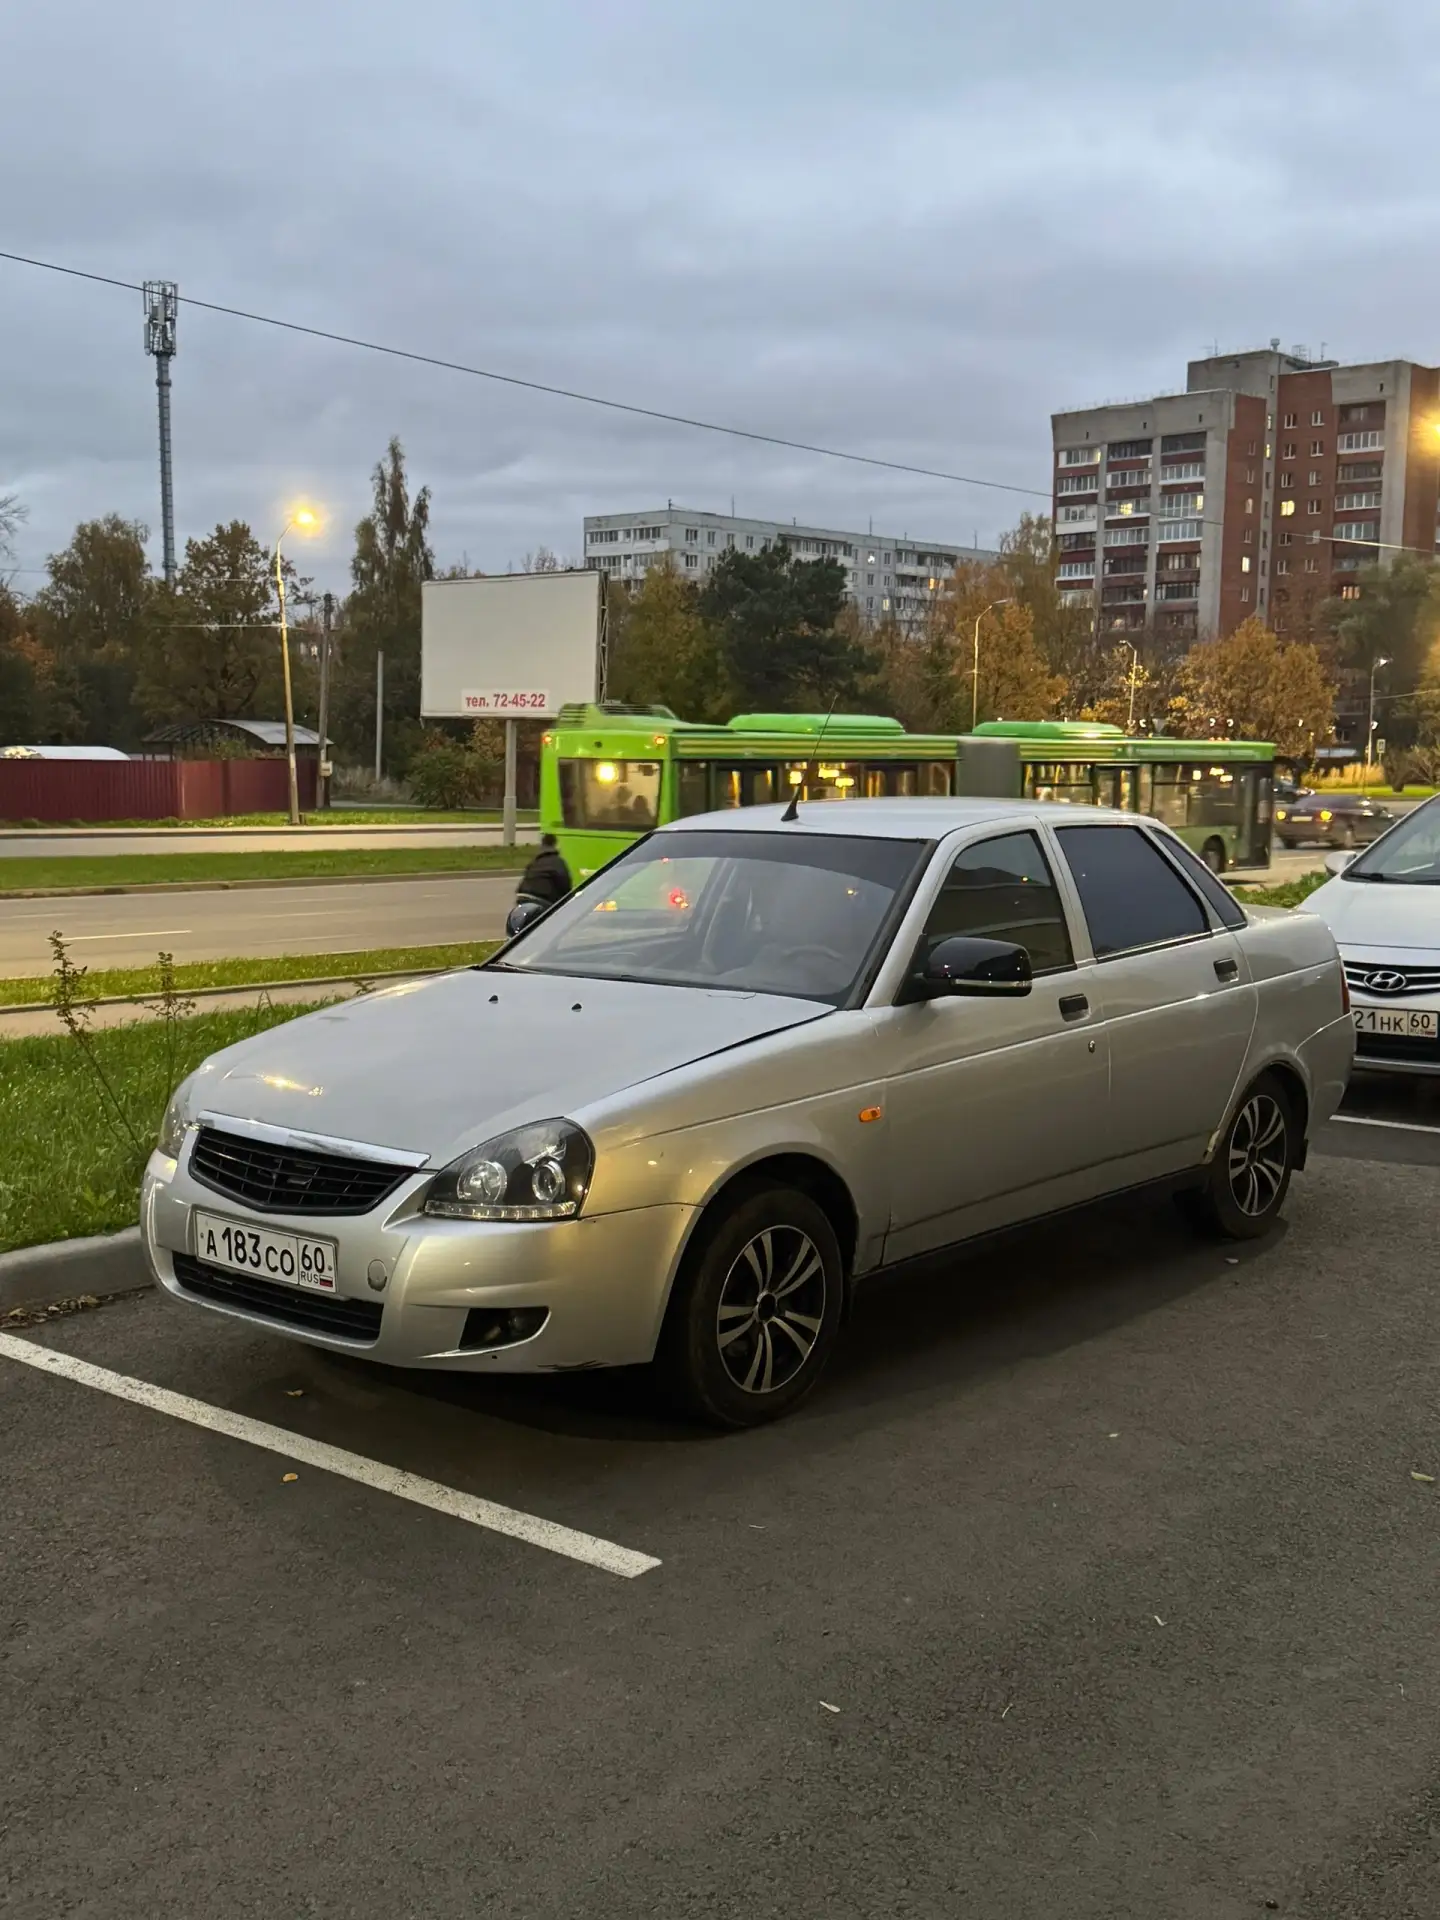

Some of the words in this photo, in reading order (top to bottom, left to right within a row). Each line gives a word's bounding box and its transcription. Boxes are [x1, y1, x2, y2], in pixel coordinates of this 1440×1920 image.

[465, 696, 489, 707] тел.
[493, 694, 545, 708] 72-45-22
[1410, 1013, 1430, 1029] 60
[301, 1244, 325, 1273] 60
[300, 1270, 319, 1284] RUS
